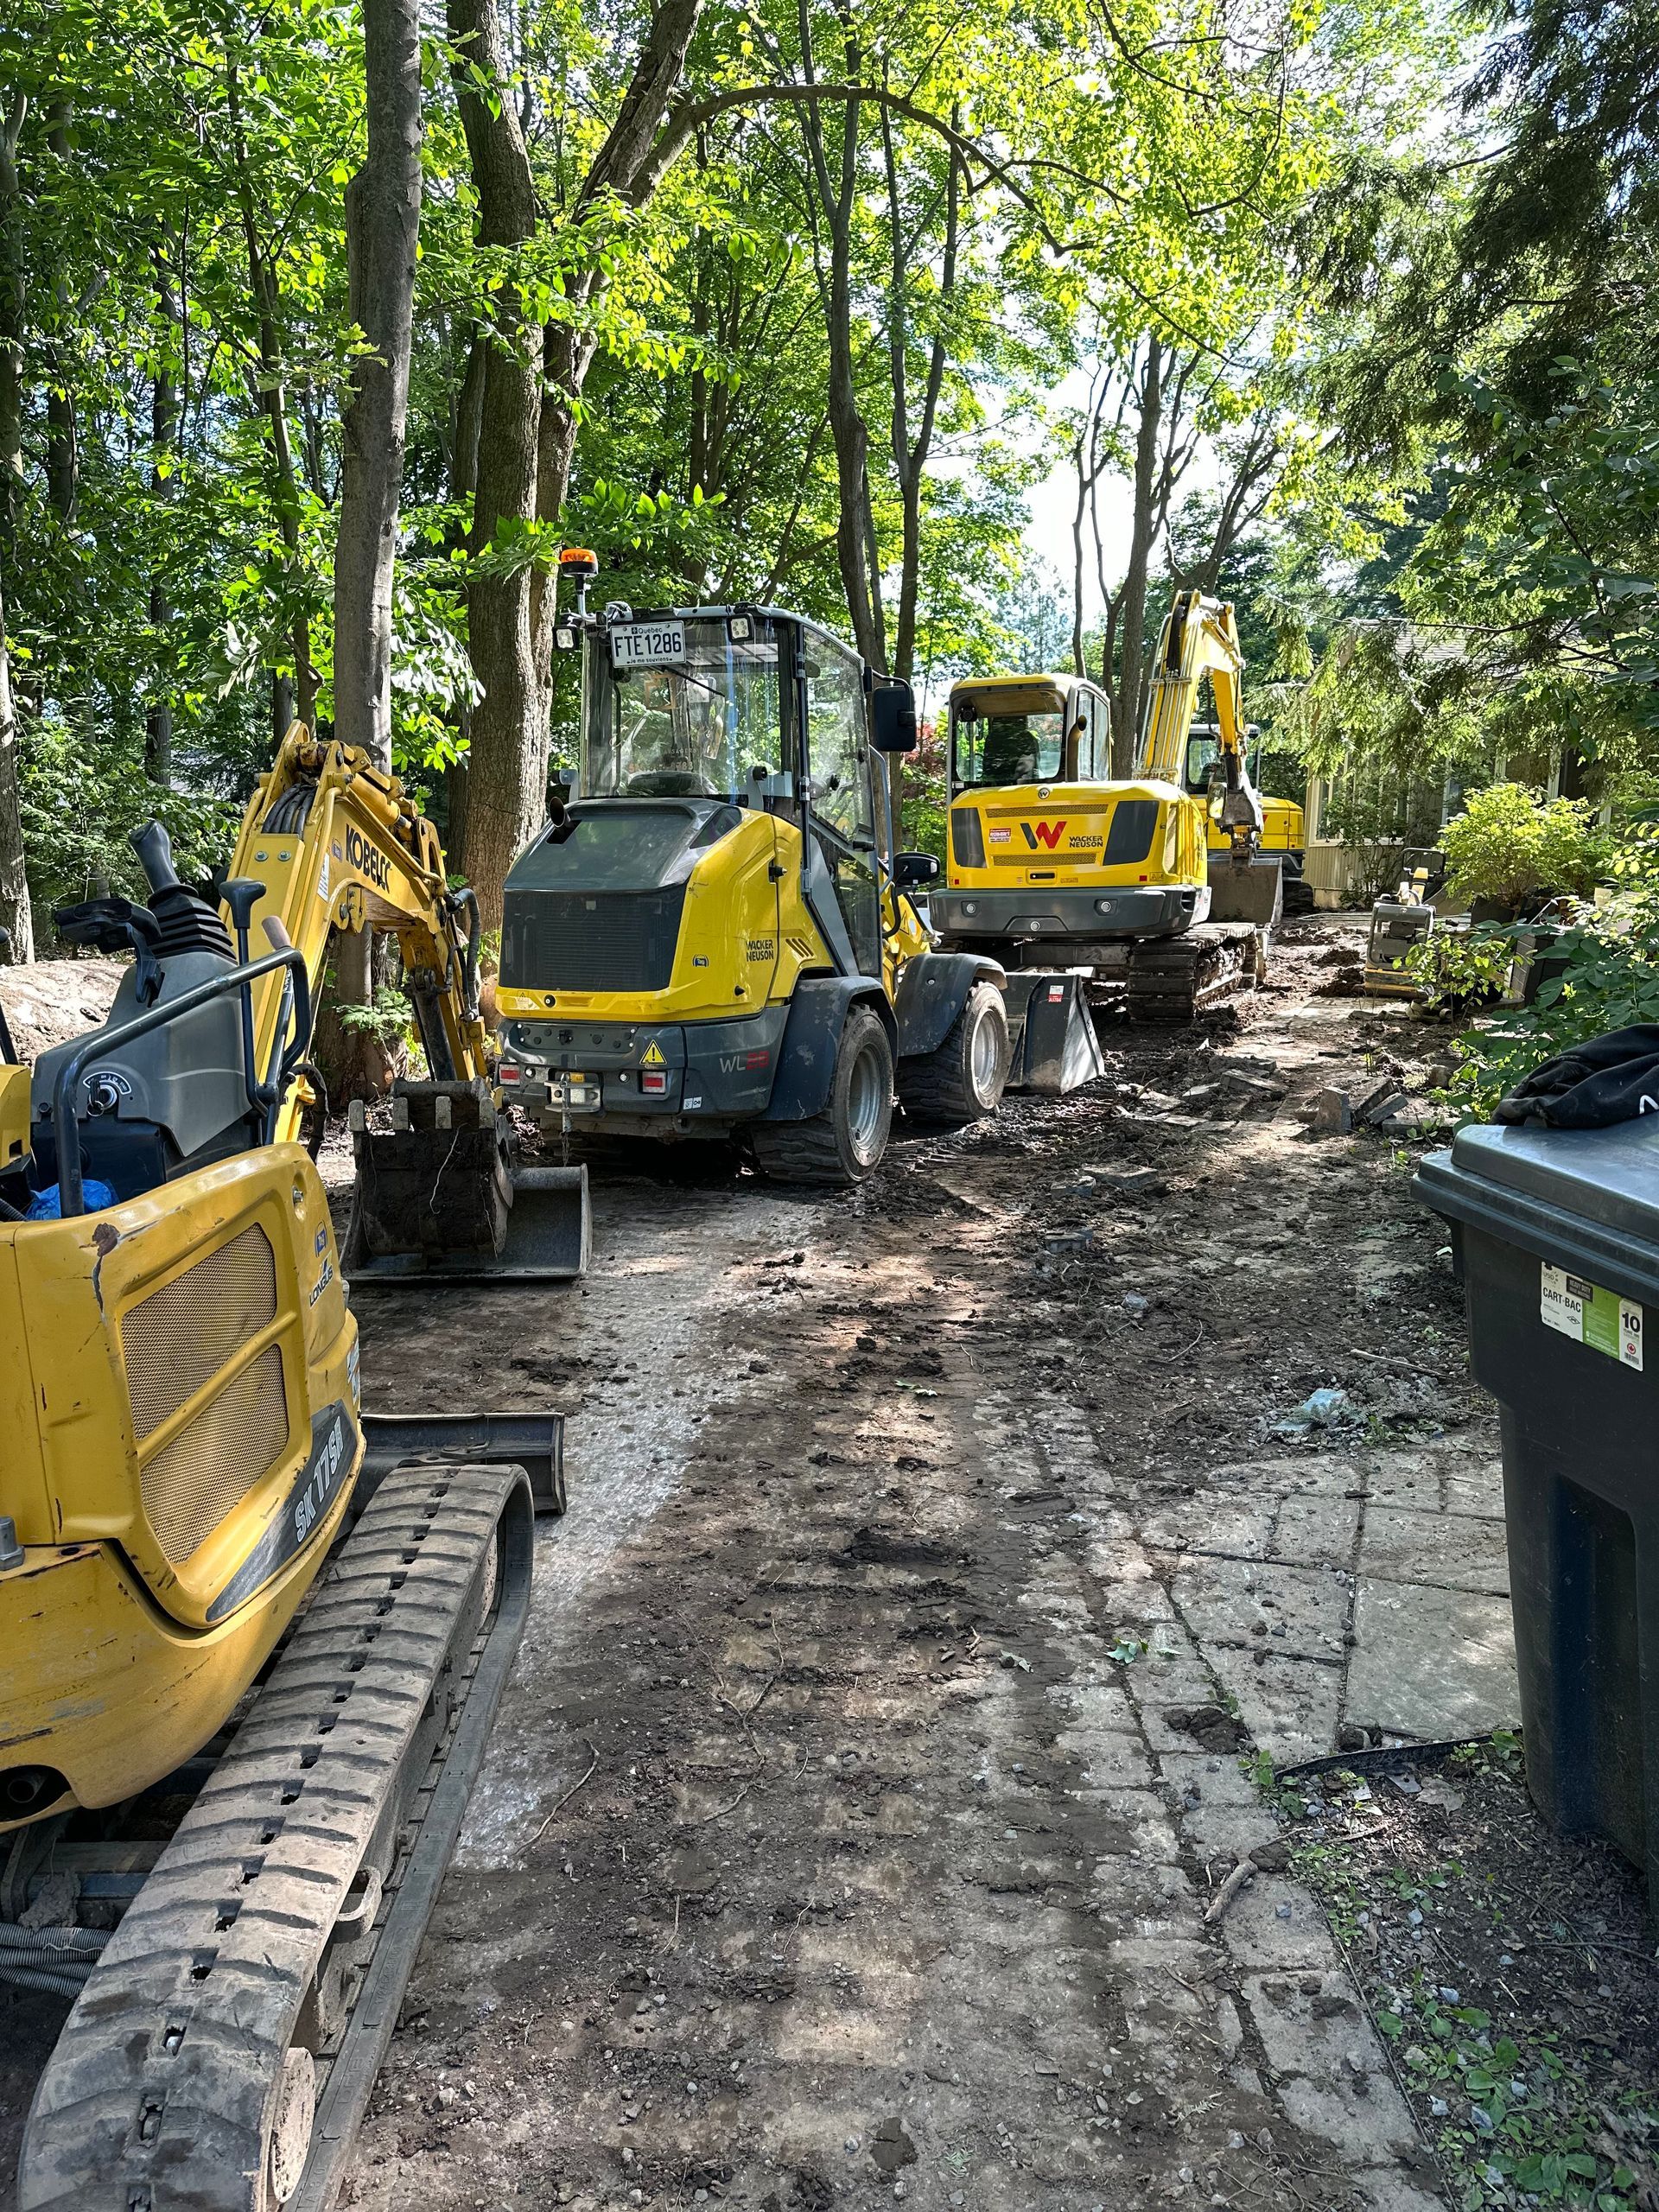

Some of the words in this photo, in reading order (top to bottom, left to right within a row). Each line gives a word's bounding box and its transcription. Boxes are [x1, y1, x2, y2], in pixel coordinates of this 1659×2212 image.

[614, 632, 681, 657] FTE1286
[746, 939, 773, 950] WACKER
[747, 950, 774, 962] NEUSON
[309, 1264, 333, 1307] LONGUS
[1622, 1313, 1641, 1332] 10
[295, 1483, 316, 1542] SK
[314, 1416, 344, 1503] 77SR
